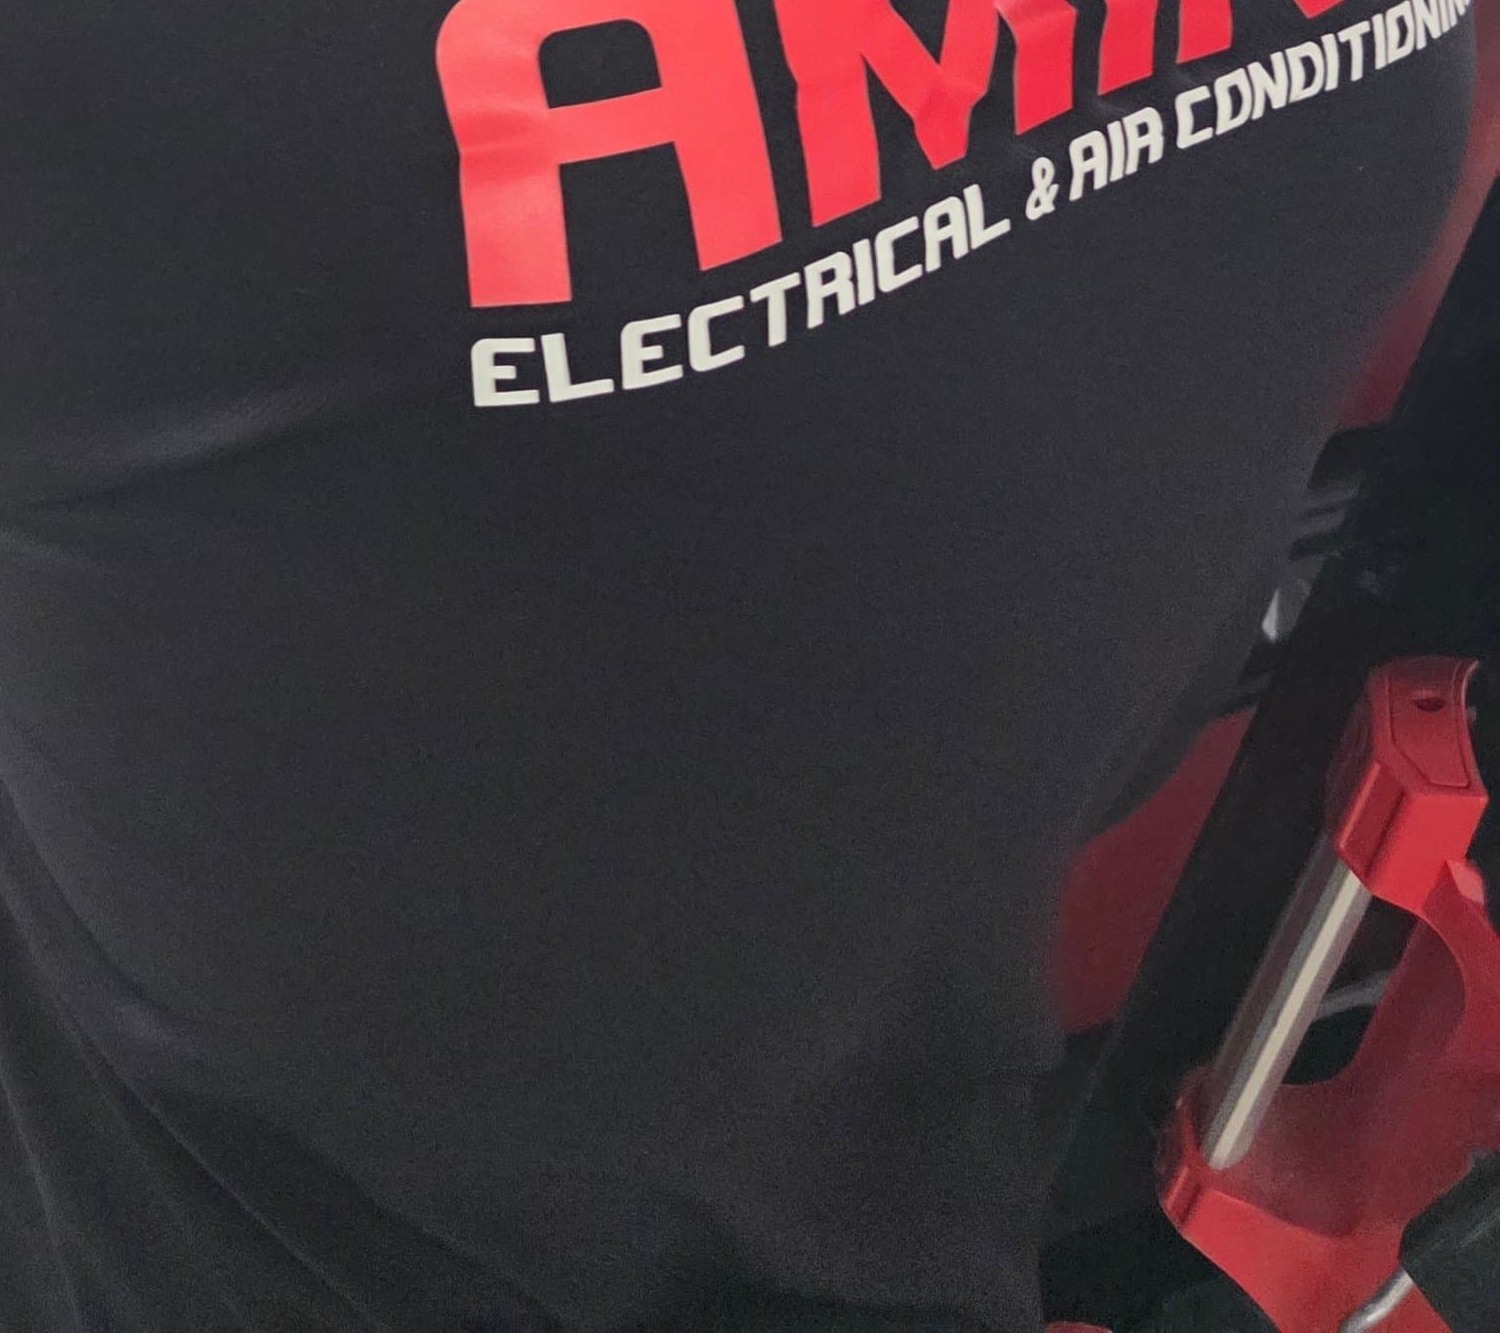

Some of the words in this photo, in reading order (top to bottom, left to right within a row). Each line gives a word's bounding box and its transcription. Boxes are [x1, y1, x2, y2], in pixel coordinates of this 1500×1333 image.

[470, 183, 1011, 408] ELECTRICAL
[1024, 156, 1060, 221] &
[1068, 106, 1165, 202] AIR
